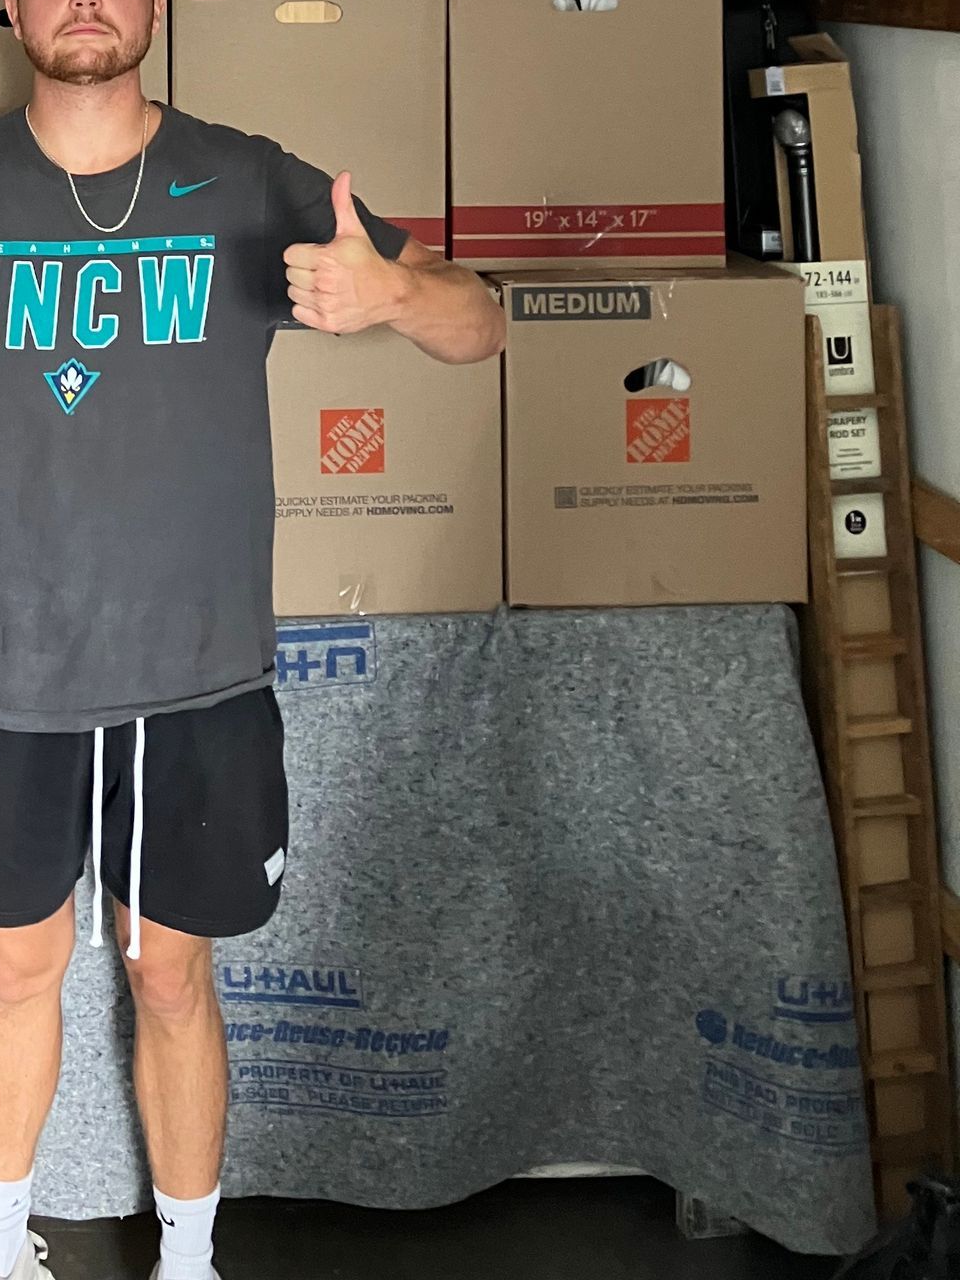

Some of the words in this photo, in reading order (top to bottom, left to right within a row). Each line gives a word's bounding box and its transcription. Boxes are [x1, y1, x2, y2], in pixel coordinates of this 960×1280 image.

[559, 215, 570, 228] x
[612, 215, 624, 228] x
[805, 270, 851, 287] 72-144
[523, 292, 641, 315] MEDIUM
[327, 415, 354, 442] THE
[626, 398, 691, 464] HOME
[321, 408, 384, 475] HOME
[651, 422, 691, 463] DEPOT
[346, 433, 385, 474] DEPOT
[275, 496, 318, 507] QUICKLY
[320, 495, 368, 506] ESTIMATE
[370, 494, 401, 505] YOUR
[402, 493, 448, 504] PACKING
[275, 507, 313, 518] SUPPLY
[316, 507, 350, 517] NEEDS
[352, 507, 366, 516] AT
[366, 504, 454, 516] HDMOVING.COM
[239, 1065, 333, 1084] PROPERTY
[308, 1088, 376, 1109] PLEASE
